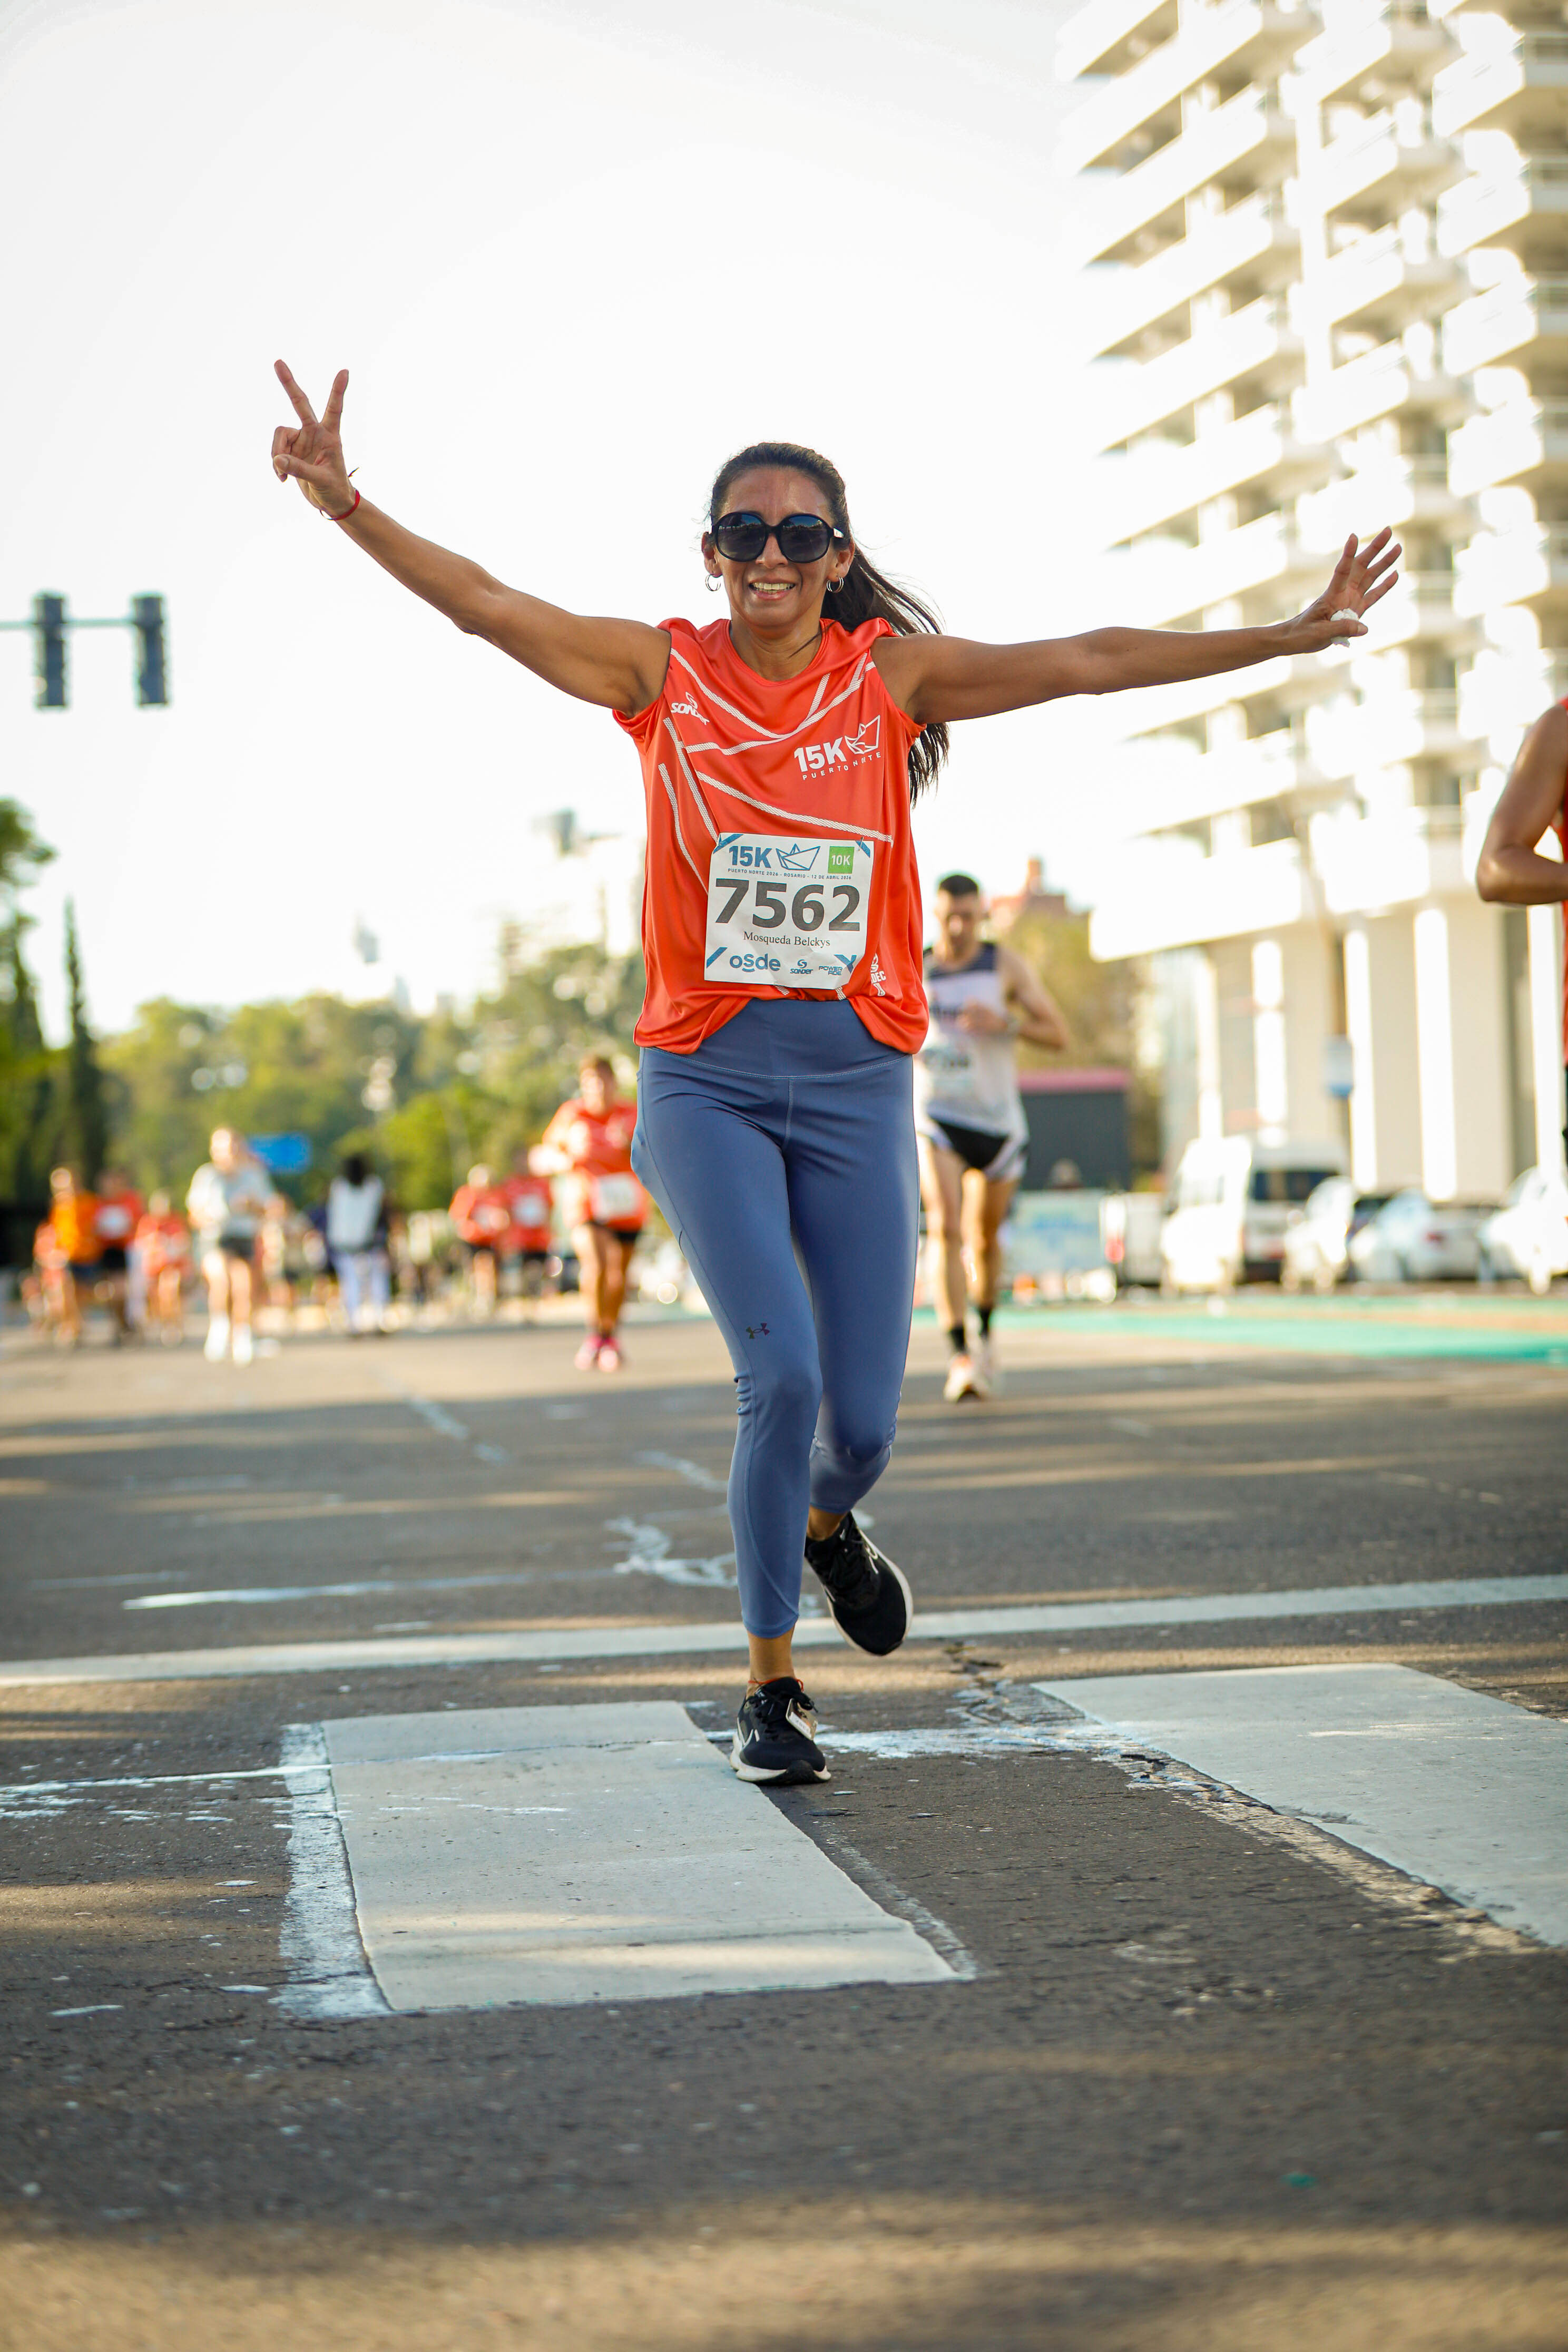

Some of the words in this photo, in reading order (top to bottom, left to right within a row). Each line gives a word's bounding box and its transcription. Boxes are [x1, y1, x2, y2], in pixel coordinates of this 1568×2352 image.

[793, 737, 847, 772] 15K
[802, 765, 849, 780] PUERTO
[729, 845, 772, 869] 15K
[831, 855, 851, 866] 10K
[715, 878, 860, 932] 7562
[743, 931, 791, 945] Mosqueda
[794, 936, 831, 948] Belckys
[729, 953, 781, 972] osde
